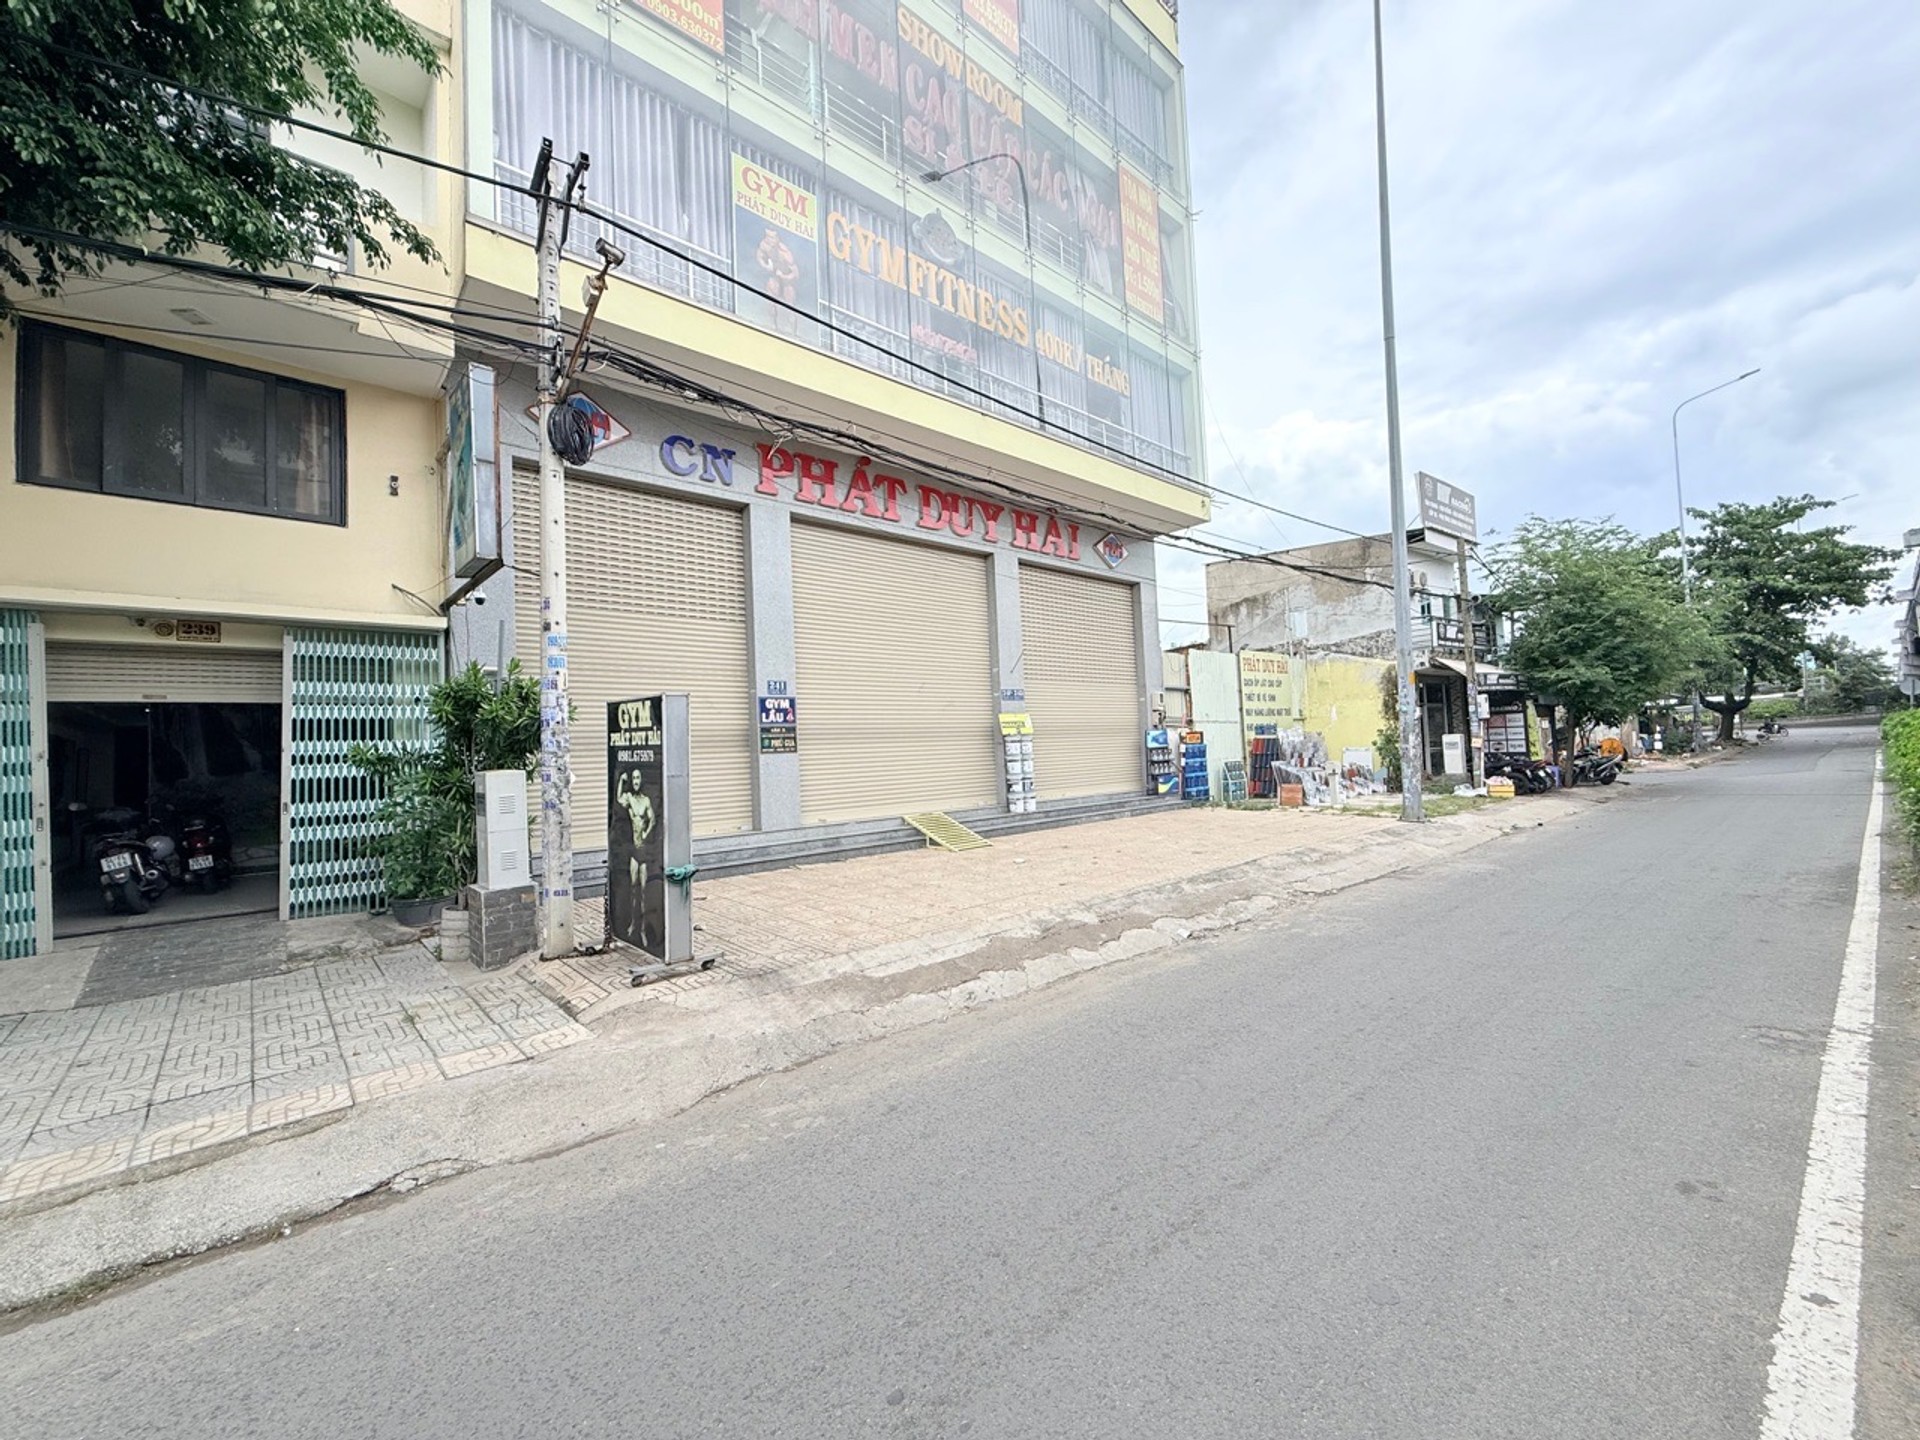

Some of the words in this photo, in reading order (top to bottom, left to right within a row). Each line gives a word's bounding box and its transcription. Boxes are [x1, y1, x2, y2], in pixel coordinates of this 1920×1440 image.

[736, 190, 766, 216] PHÁT
[770, 206, 791, 228] DUY
[740, 166, 809, 219] GYM
[1085, 354, 1131, 398] THÁNG
[660, 434, 736, 486] CN
[755, 443, 907, 522] PHÁT
[916, 484, 1004, 543] DUY
[1012, 507, 1081, 561] HẢI
[182, 623, 216, 635] 239
[618, 700, 652, 729] GYM
[764, 698, 790, 709] GYM
[610, 730, 630, 746] PHÁT
[631, 731, 646, 746] DUY
